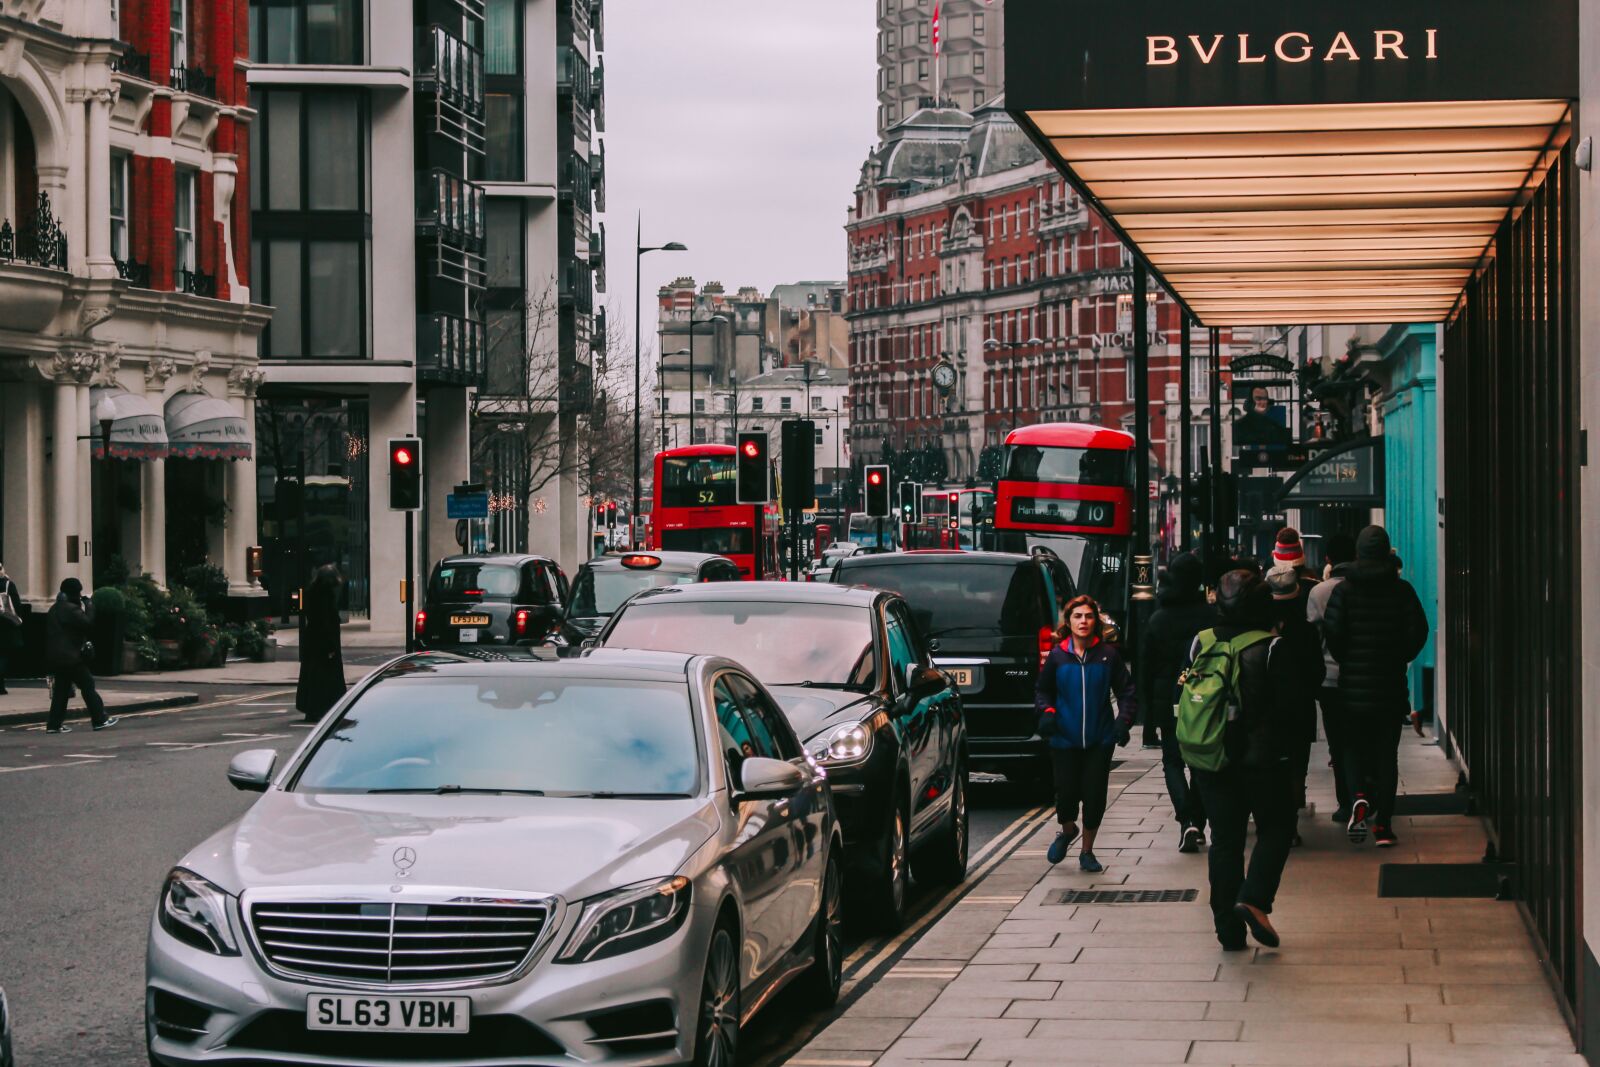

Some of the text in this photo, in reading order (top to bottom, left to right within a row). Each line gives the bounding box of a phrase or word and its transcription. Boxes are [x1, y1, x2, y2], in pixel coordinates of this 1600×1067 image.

[1145, 29, 1437, 65] BVLGARI
[1091, 331, 1167, 348] NICHLS
[699, 490, 715, 503] 52
[1088, 506, 1104, 521] 10
[318, 998, 456, 1028] SL63 VBM
